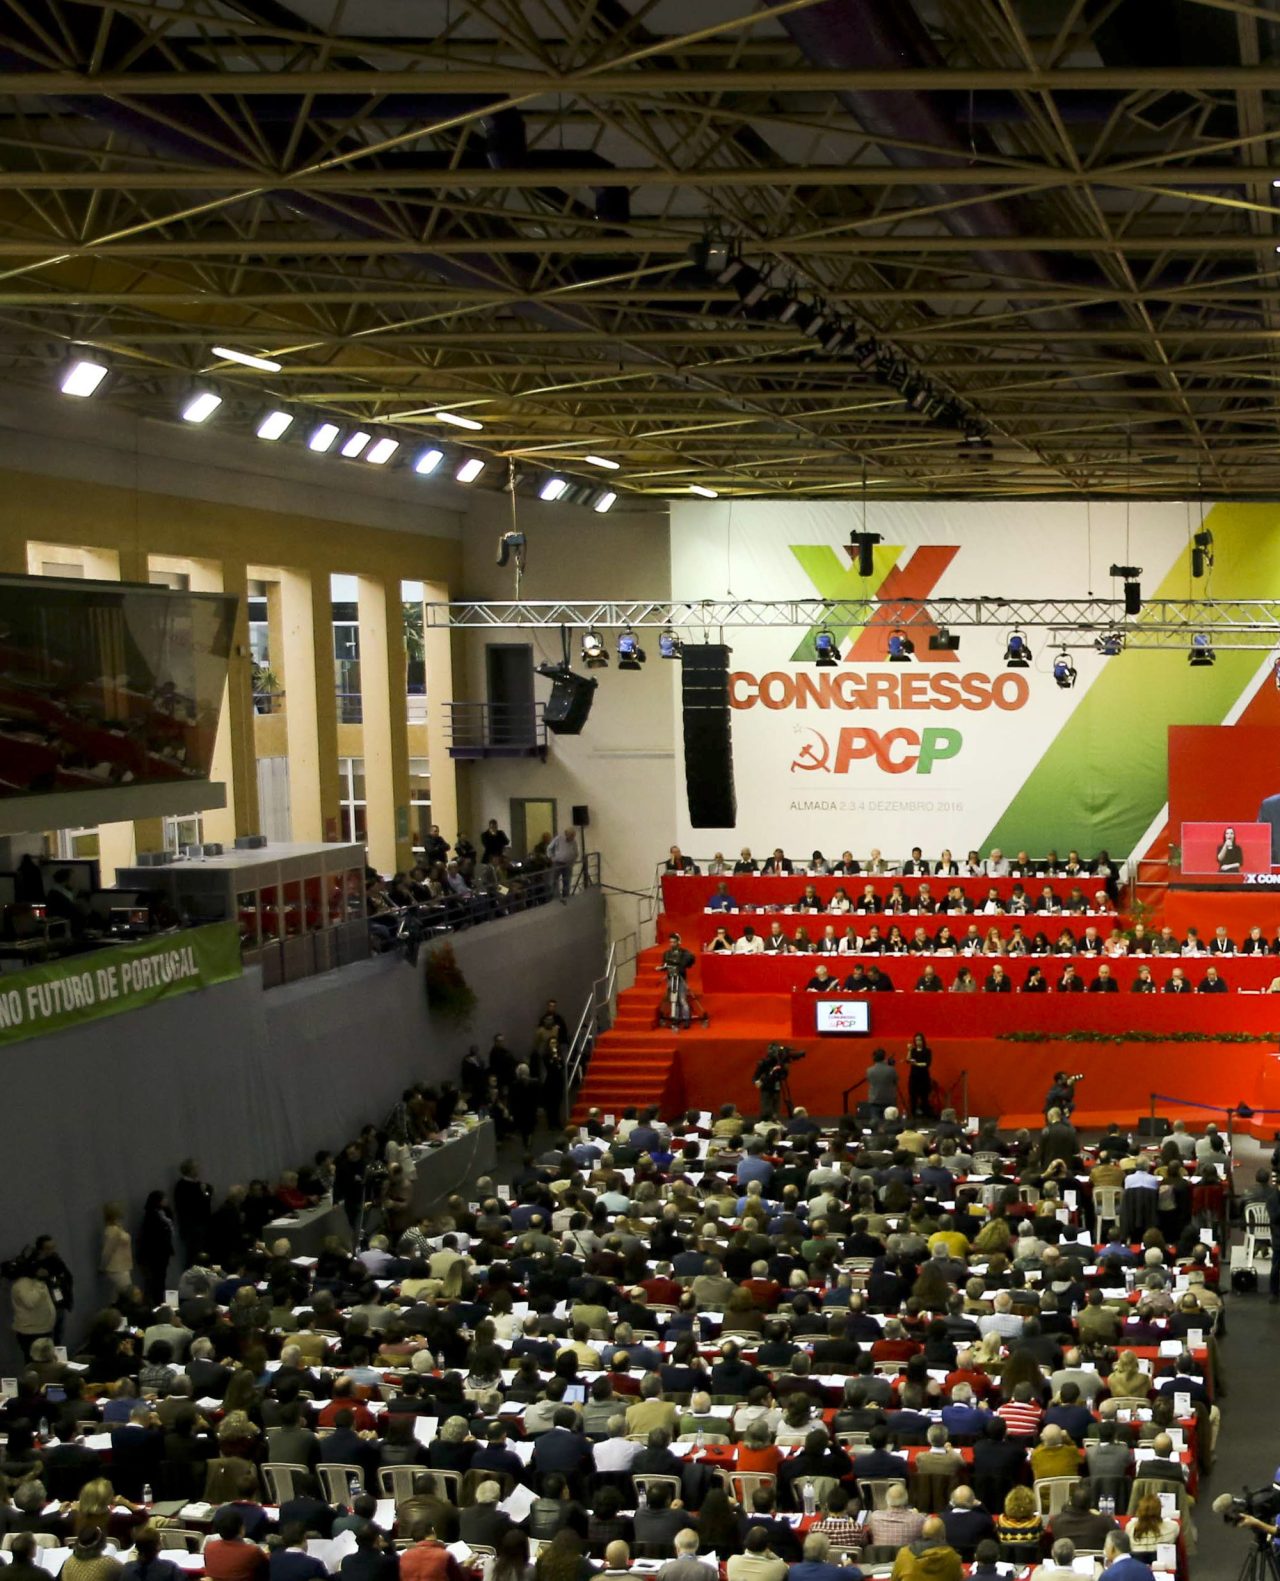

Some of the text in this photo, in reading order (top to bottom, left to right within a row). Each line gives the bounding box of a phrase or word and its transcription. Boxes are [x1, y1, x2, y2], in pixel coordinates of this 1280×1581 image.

[728, 671, 1030, 711] CONGRESSO
[833, 727, 963, 774] PCP
[790, 801, 837, 811] ALMADA
[868, 802, 934, 812] DEZEMBRO
[937, 802, 964, 812] 2016
[0, 947, 199, 1028] NO FUTURO DE PORTUGAL
